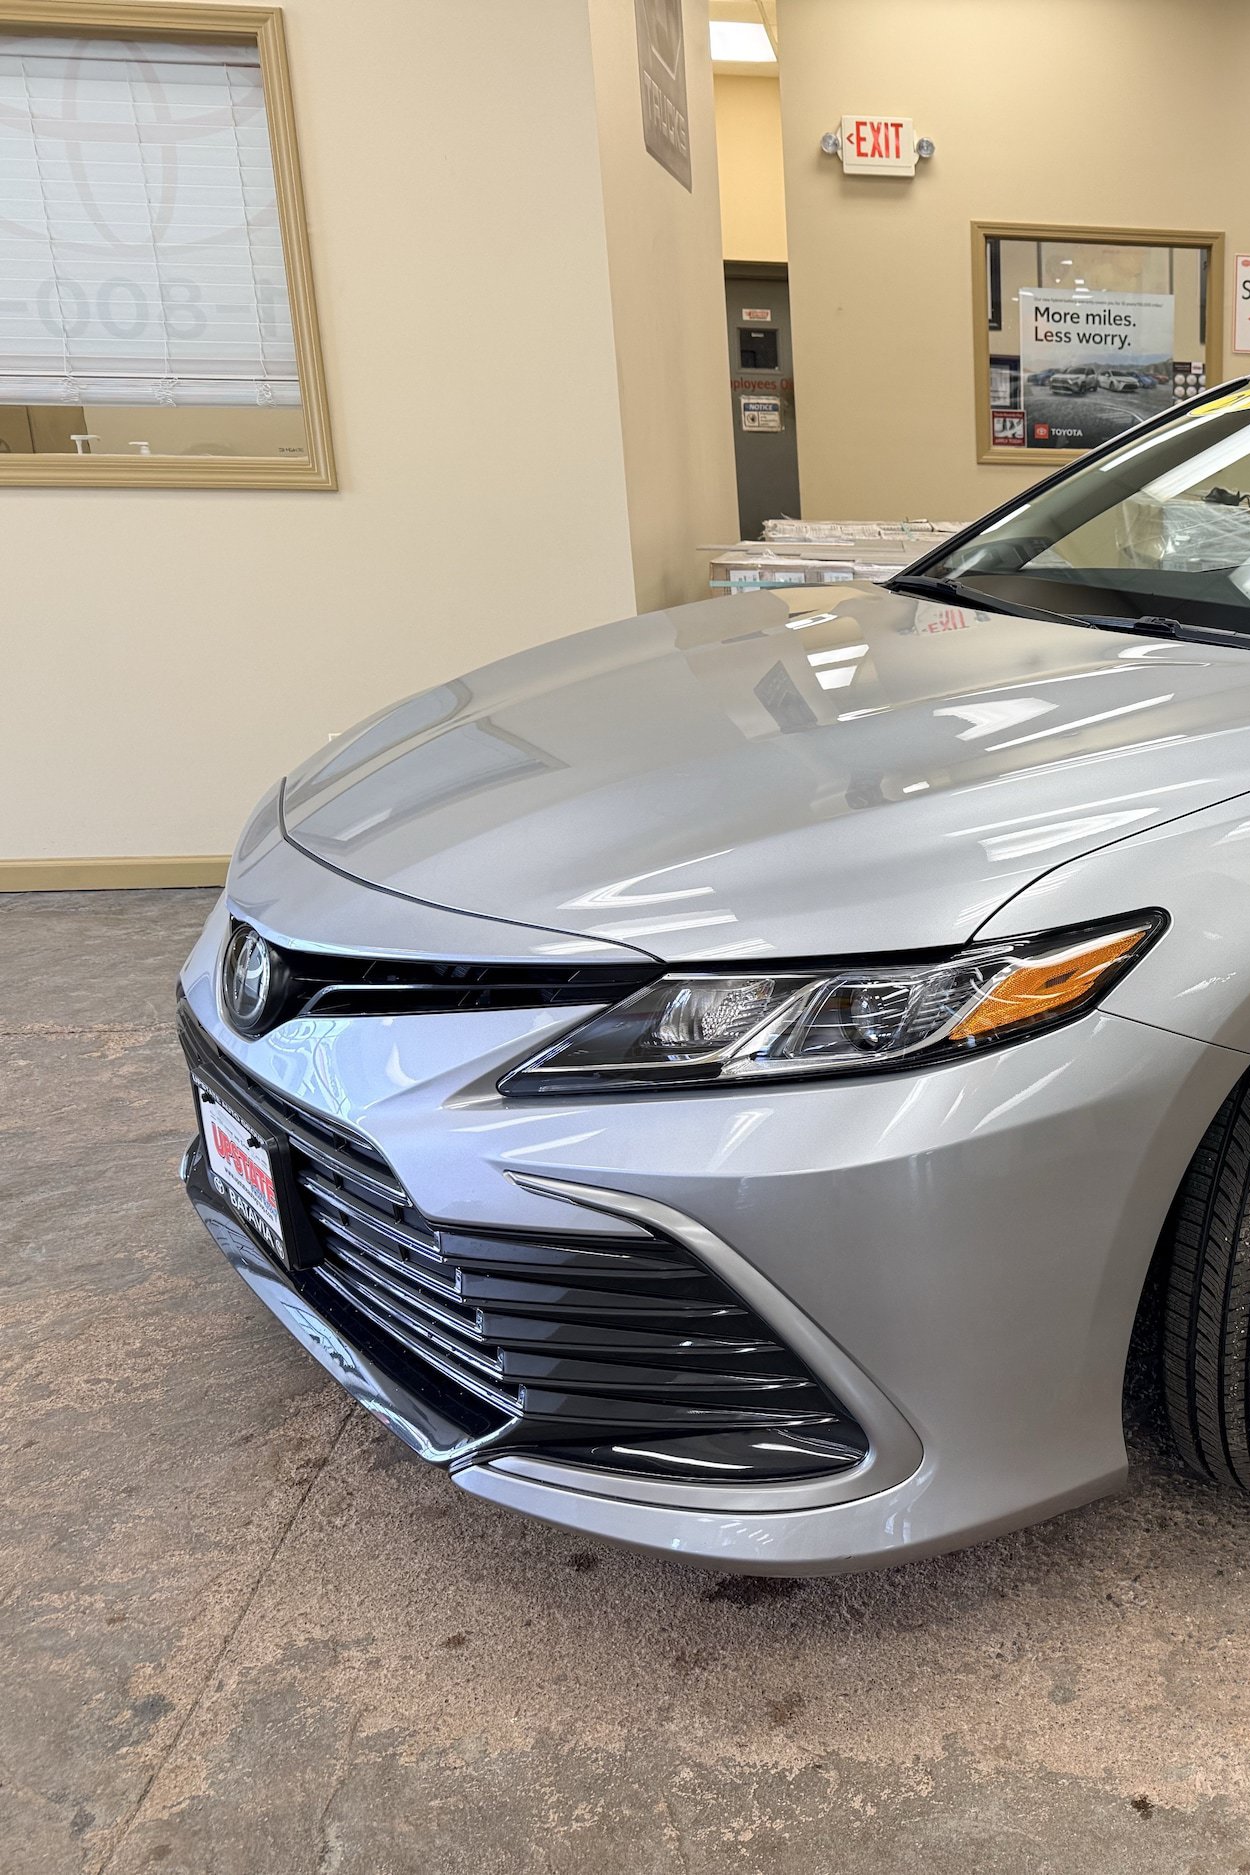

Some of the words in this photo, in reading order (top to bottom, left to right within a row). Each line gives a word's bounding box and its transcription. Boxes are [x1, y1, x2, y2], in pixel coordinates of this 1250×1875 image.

[855, 121, 903, 159] EXIT
[1034, 306, 1080, 323] More
[1085, 309, 1137, 327] miles.
[1034, 326, 1072, 343] Less
[1076, 333, 1131, 350] worry.
[749, 404, 773, 412] NOTICE
[1051, 428, 1083, 437] TOYOTA
[211, 1121, 277, 1209] UPSTATE
[228, 1187, 275, 1249] BATAVIA
